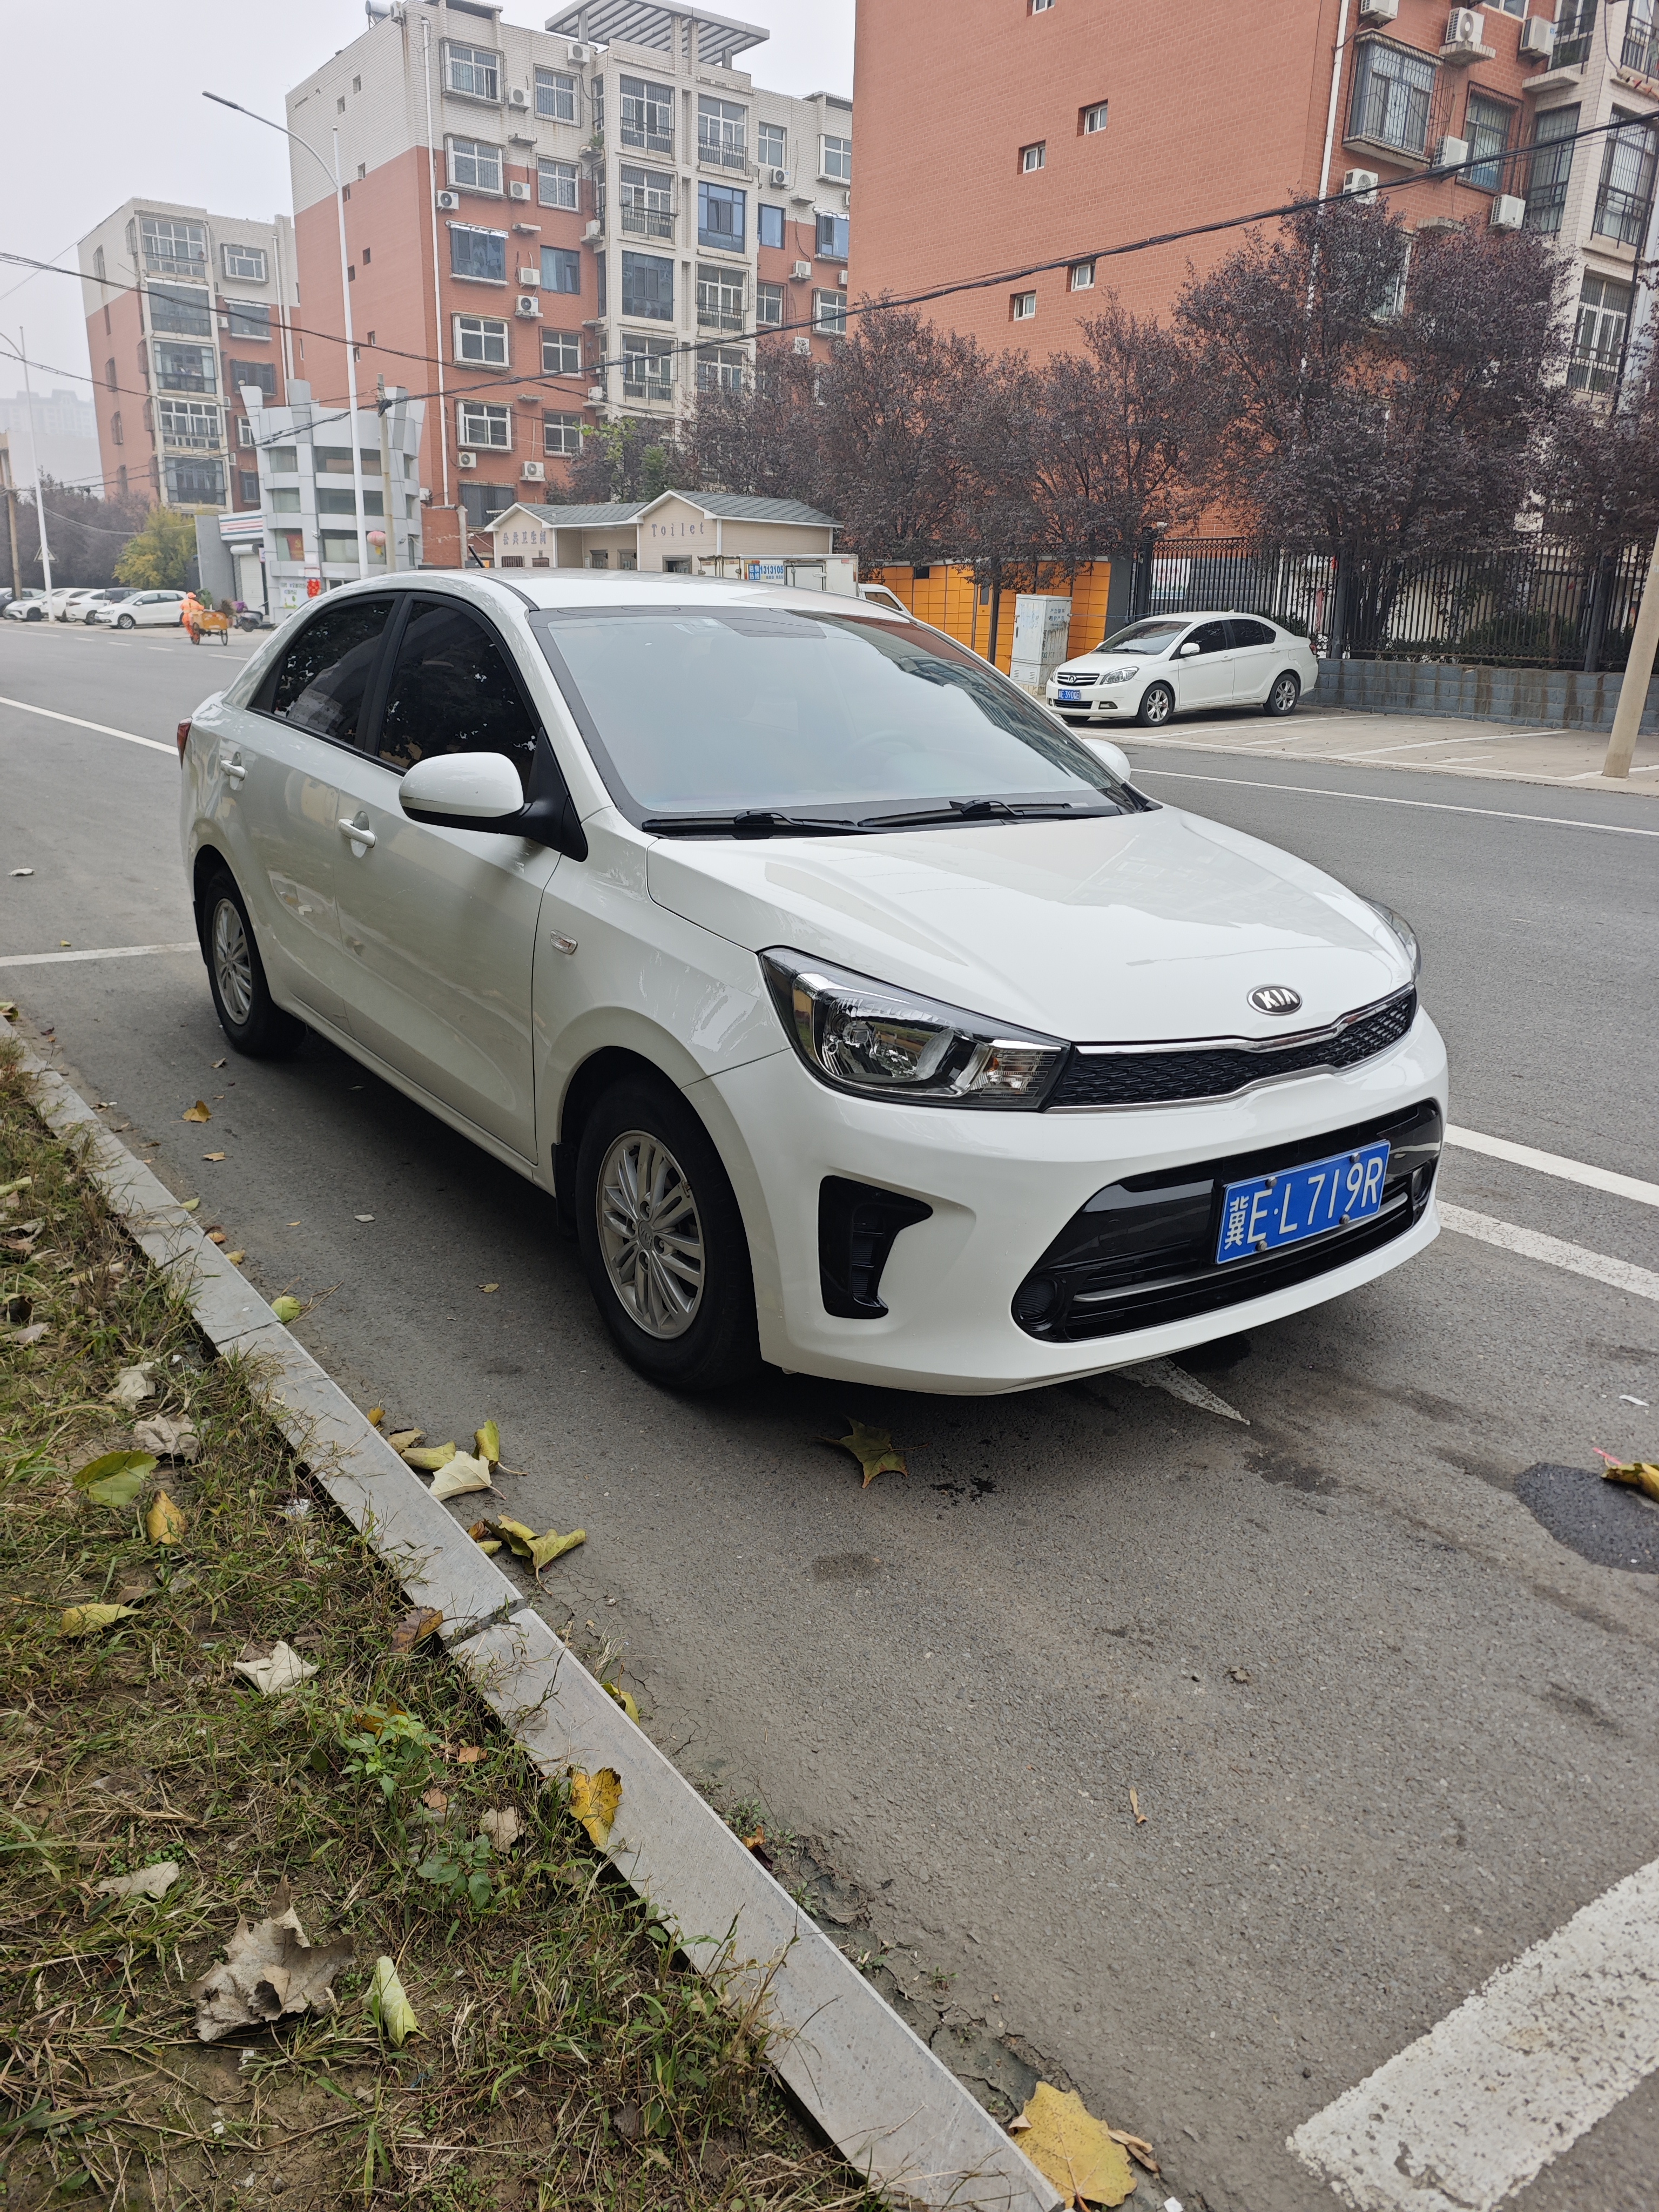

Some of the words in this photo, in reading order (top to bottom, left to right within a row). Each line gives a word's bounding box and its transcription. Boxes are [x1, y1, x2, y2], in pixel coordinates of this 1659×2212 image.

[503, 530, 546, 545] 公共卫生间
[651, 522, 704, 537] Toilet
[1256, 988, 1299, 1009] KIA
[1224, 1156, 1384, 1250] 冀E·L719R
